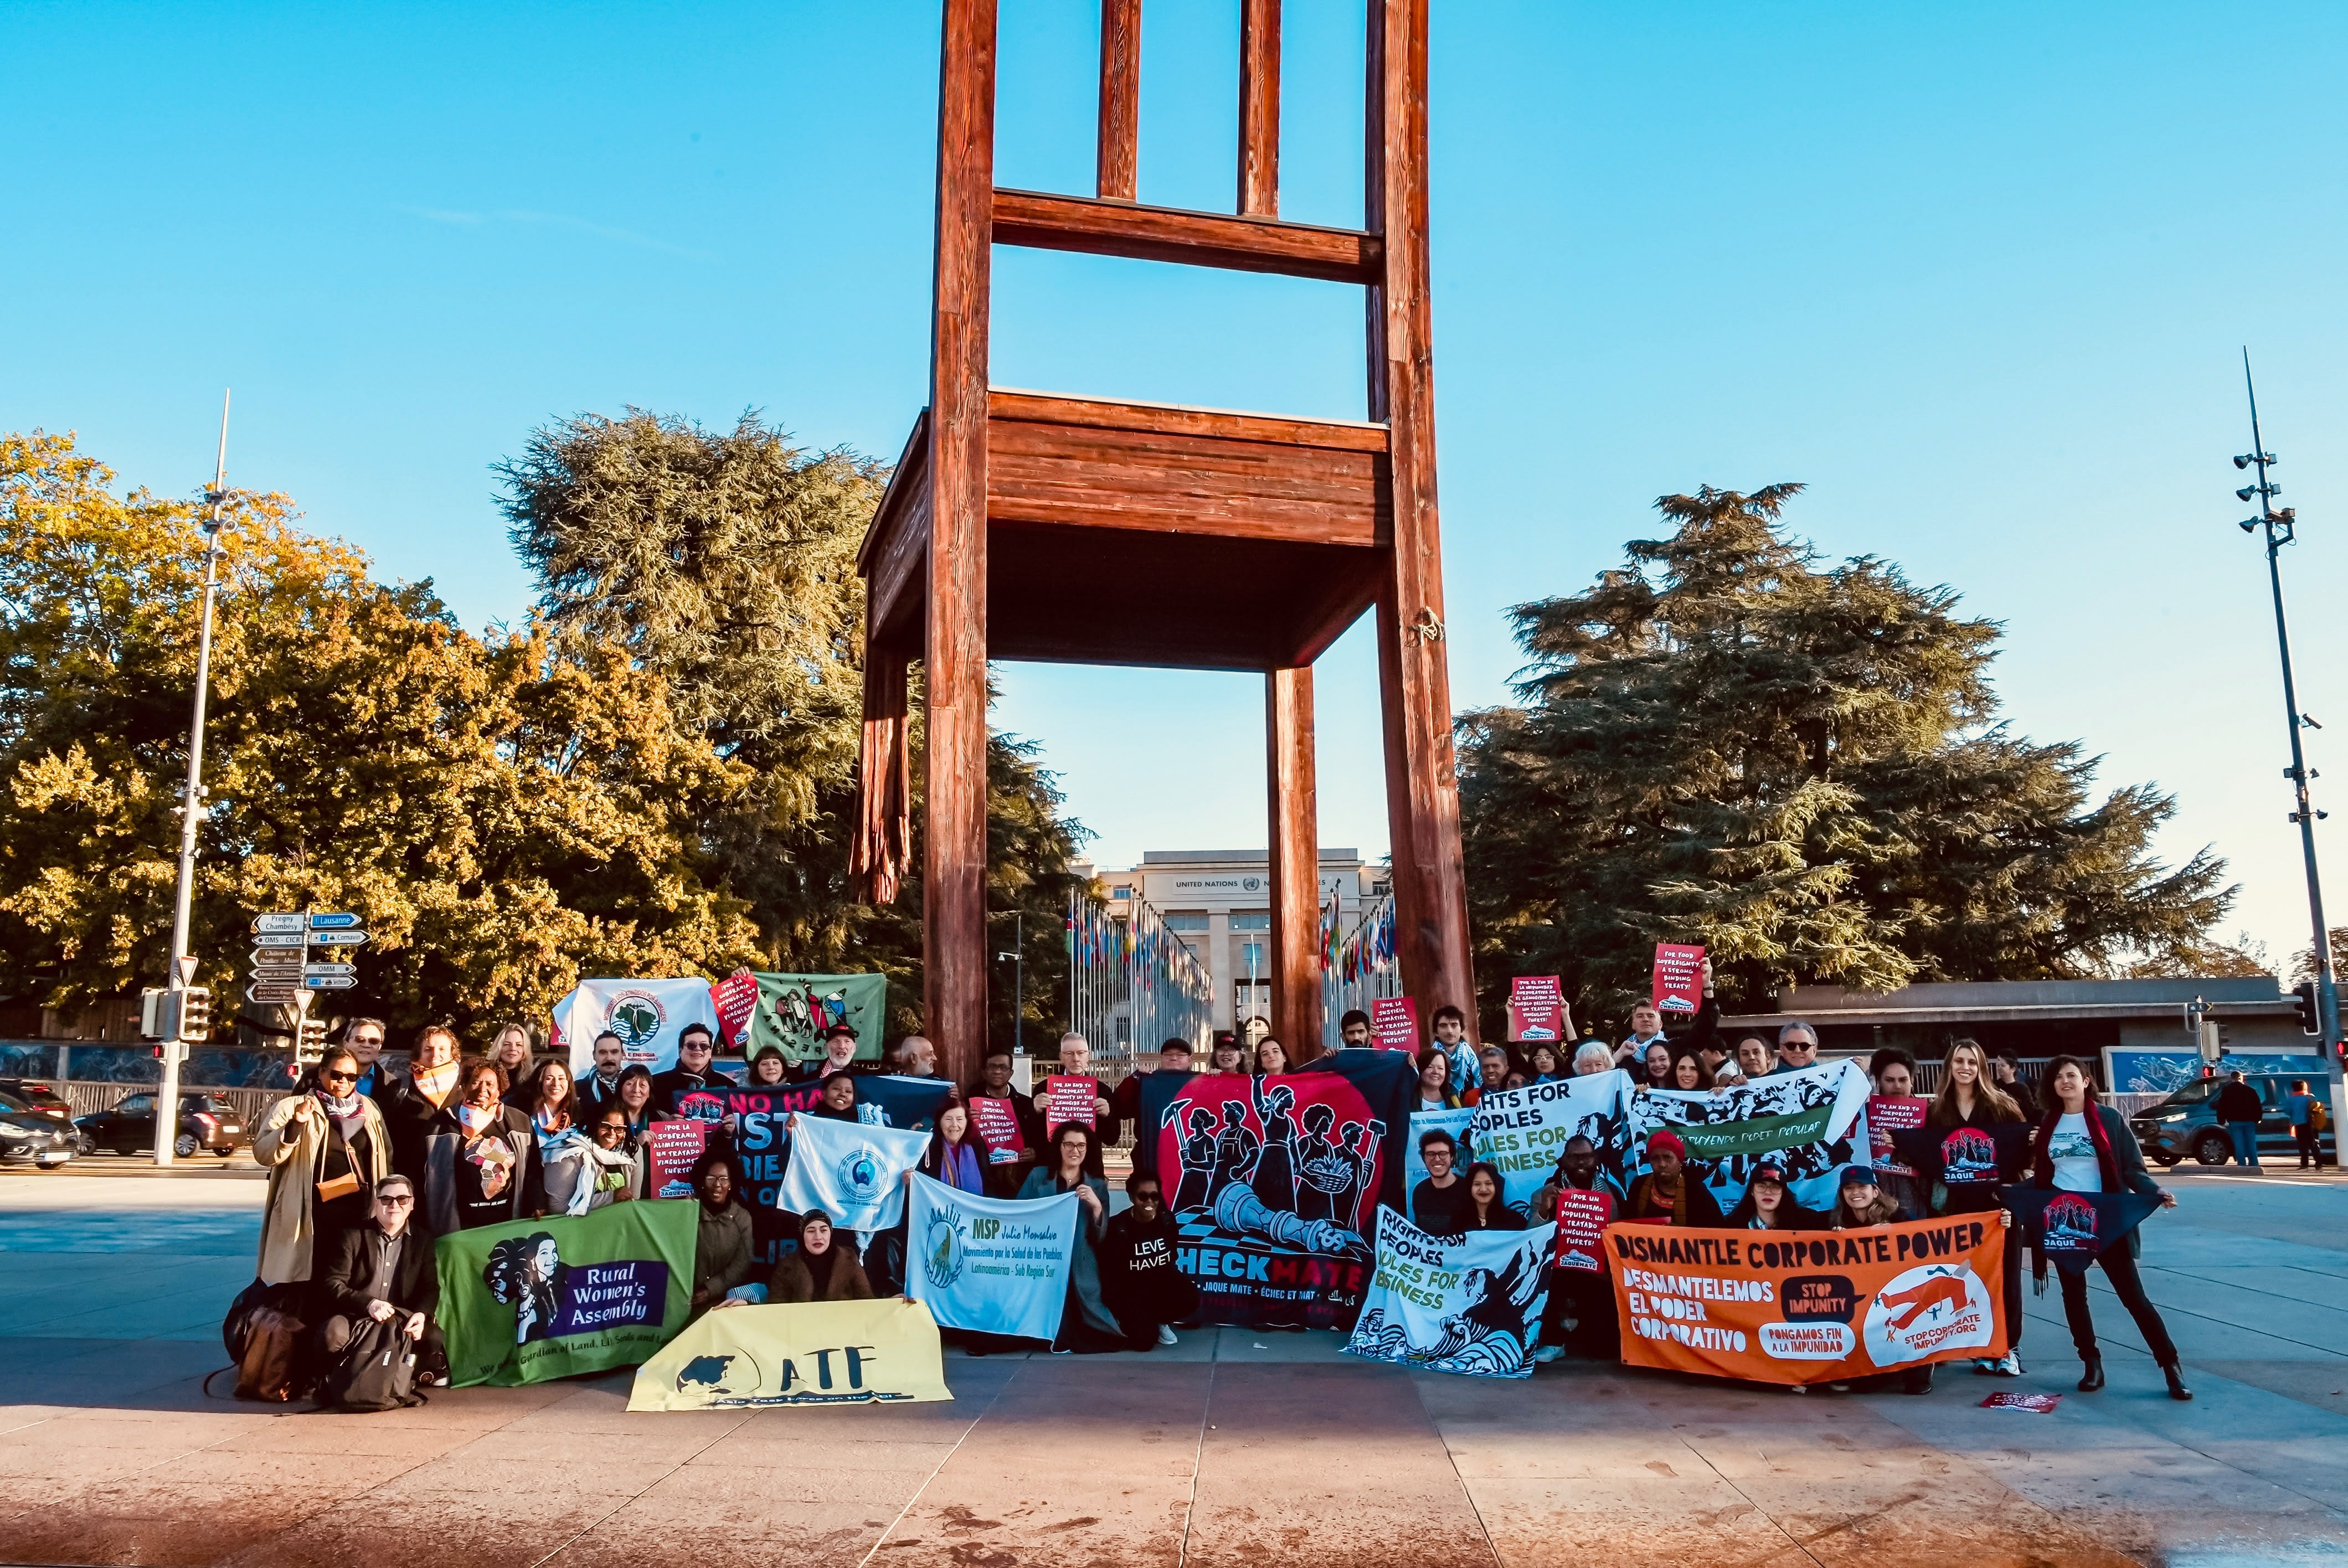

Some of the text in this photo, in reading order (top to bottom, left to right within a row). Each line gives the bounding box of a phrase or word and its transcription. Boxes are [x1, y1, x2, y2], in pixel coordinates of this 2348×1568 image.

[726, 997, 752, 1011] TRATADO
[1527, 1082, 1571, 1105] FOR
[1479, 1108, 1543, 1132] OPLES
[988, 1135, 1012, 1144] FUERTE!
[1526, 1126, 1567, 1148] FOR
[1564, 1201, 1604, 1211] FEMINISMO
[972, 1218, 1000, 1240] MSP
[1001, 1225, 1021, 1240] Julio
[1561, 1228, 1602, 1239] VINCULANTE
[1567, 1220, 1597, 1229] TRATADO
[1135, 1238, 1166, 1256] LEVE
[1379, 1228, 1444, 1267] PEOPLES
[1566, 1237, 1594, 1247] FUERTE!
[1614, 1222, 1984, 1268] DISMANTLE CORPORATE POWER
[962, 1245, 993, 1257] Movimiento
[995, 1249, 1003, 1260] por
[1005, 1246, 1010, 1258] la
[1011, 1247, 1026, 1259] Salud
[1027, 1247, 1033, 1259] de
[1043, 1247, 1063, 1260] Pueblos
[1130, 1250, 1171, 1271] HAVET
[587, 1263, 636, 1285] Rural
[971, 1261, 1055, 1280] Latinoamérica Sub Región Sur
[1561, 1261, 1596, 1269] JAQUEMATE
[1428, 1271, 1460, 1290] FOR
[1623, 1267, 1774, 1302] DESMANTELEMOS
[1802, 1282, 1832, 1298] STOP
[574, 1282, 646, 1304] Women's
[1203, 1281, 1315, 1300] JAQUE MATE ÉCHEC ET MAT
[571, 1299, 647, 1325] Assembly
[1629, 1292, 1708, 1321] EL PODER
[1789, 1298, 1847, 1313] IMPUNITY
[1630, 1316, 1747, 1353] CORPORATIVO
[1769, 1328, 1842, 1340] PONGAMOS FIN
[480, 1364, 495, 1375] We
[560, 1343, 569, 1355] of
[637, 1333, 653, 1342] and
[1772, 1341, 1843, 1353] A LA IMPUNIDAD
[780, 1347, 877, 1392] ATF
